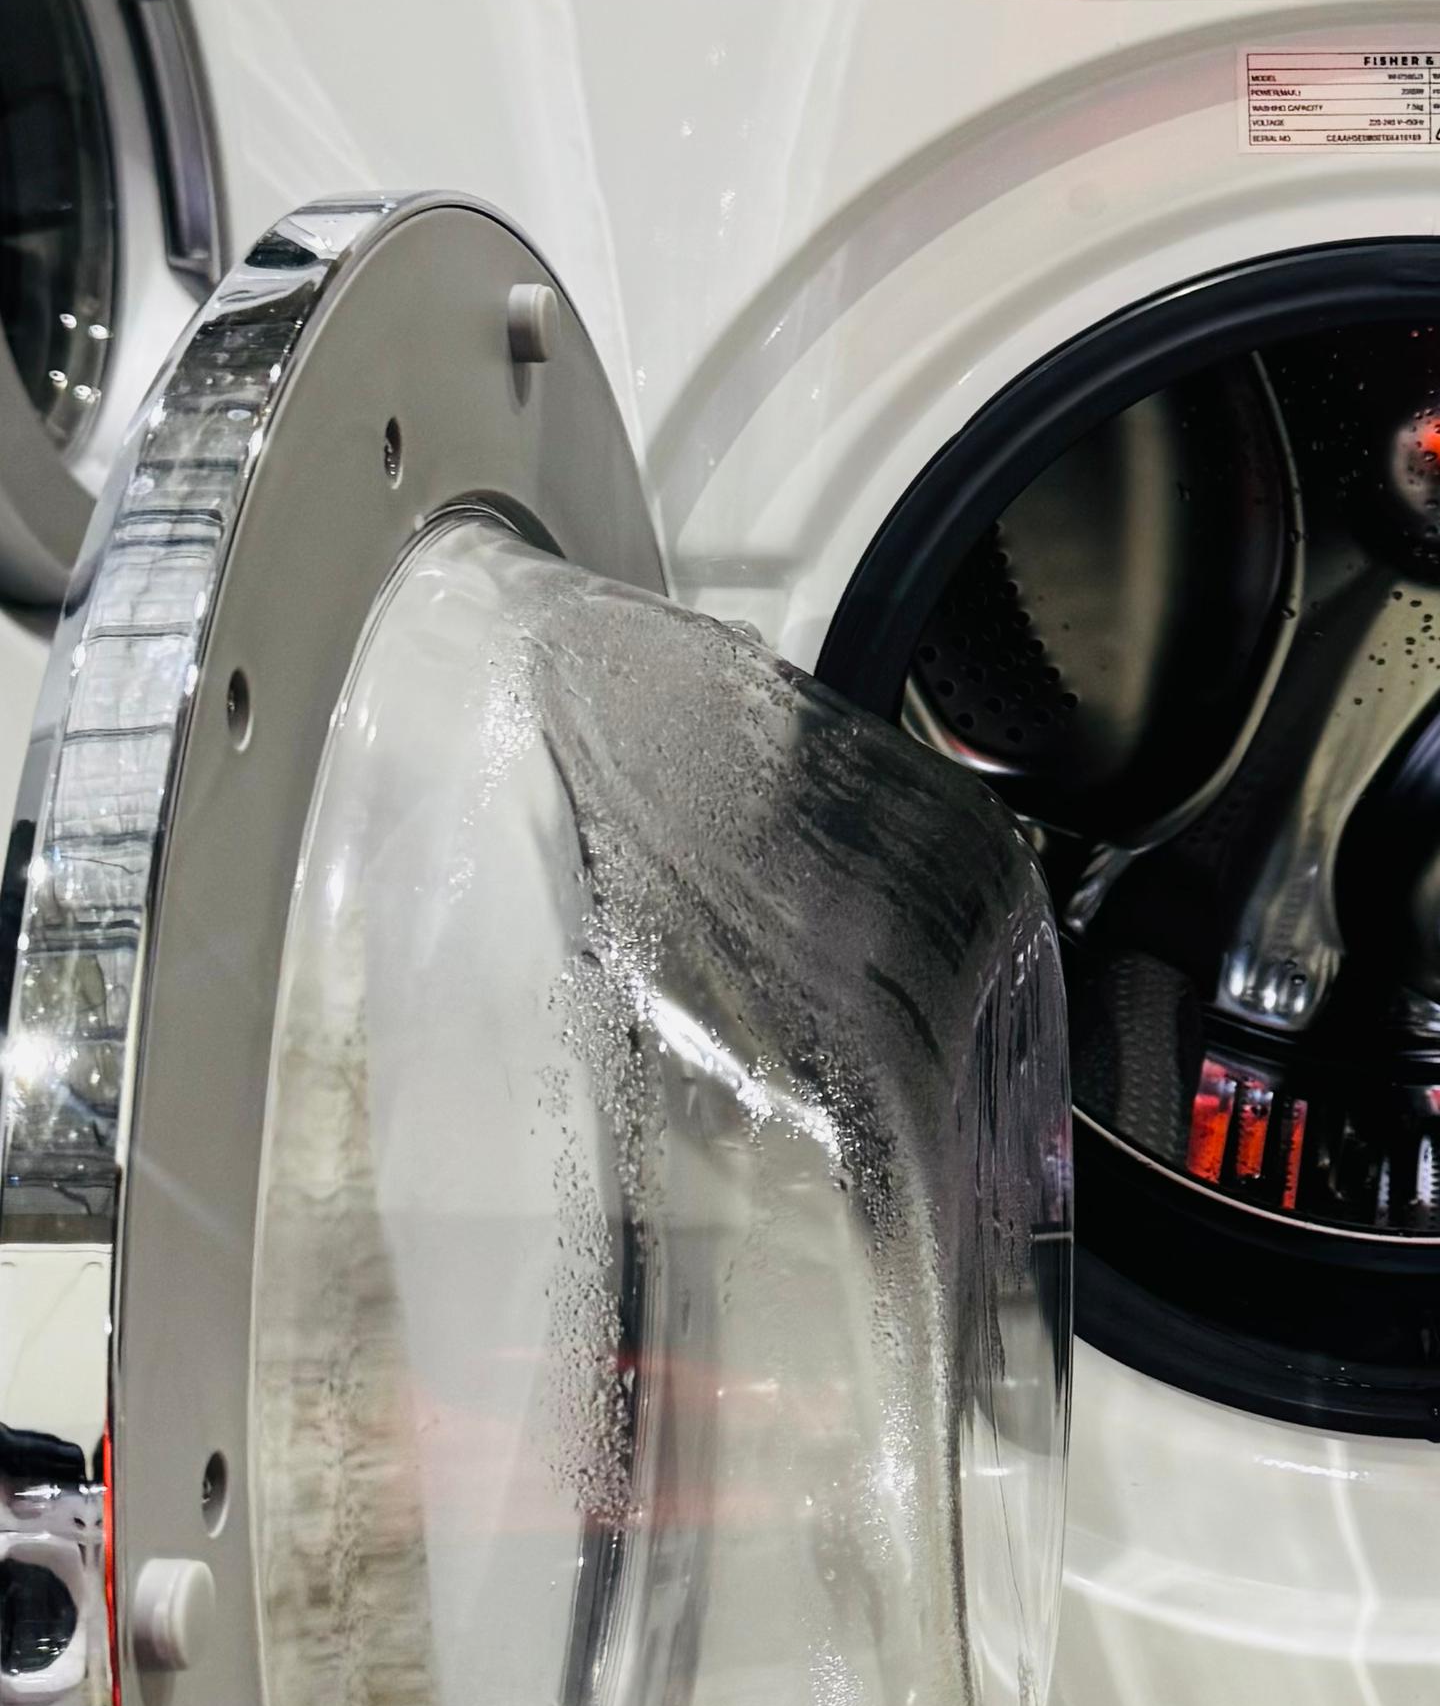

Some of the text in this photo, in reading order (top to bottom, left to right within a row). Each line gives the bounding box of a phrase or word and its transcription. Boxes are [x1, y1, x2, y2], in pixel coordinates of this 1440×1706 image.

[1364, 56, 1419, 65] FISHER
[1426, 56, 1433, 65] &
[1251, 74, 1276, 82] MODEL
